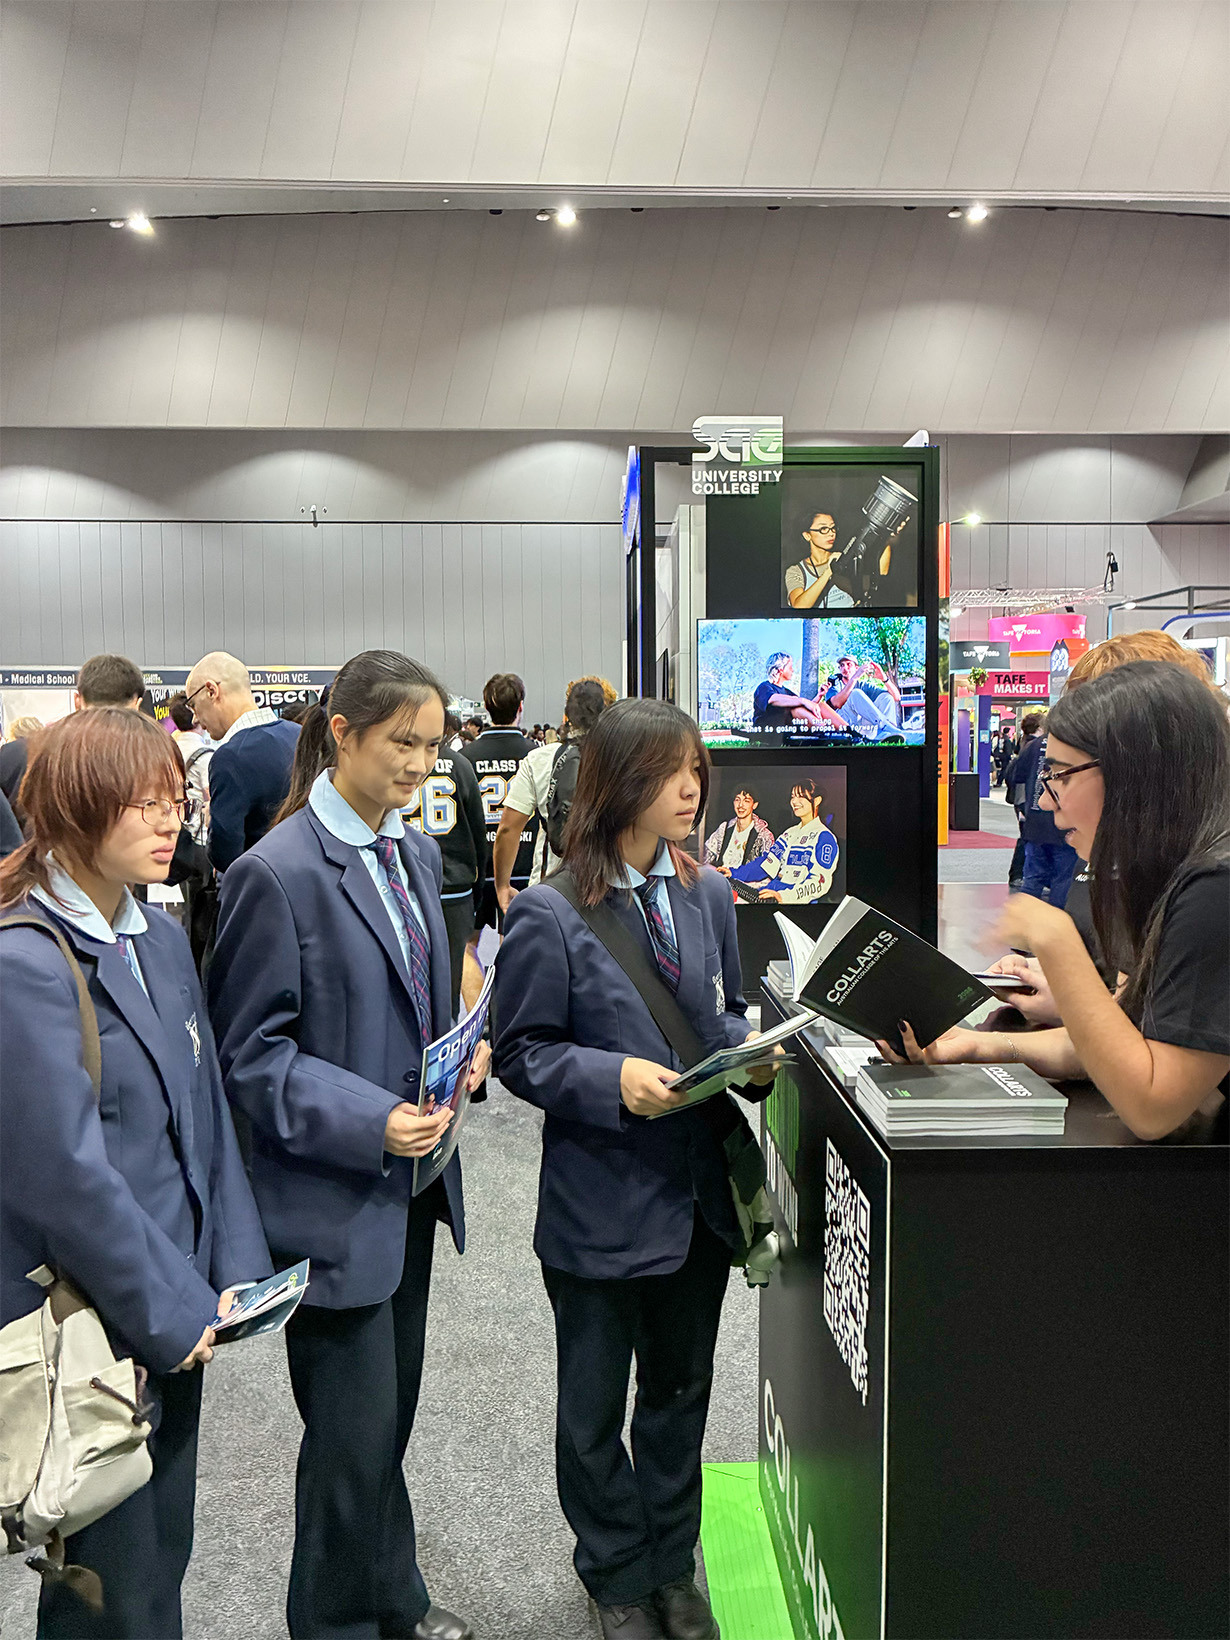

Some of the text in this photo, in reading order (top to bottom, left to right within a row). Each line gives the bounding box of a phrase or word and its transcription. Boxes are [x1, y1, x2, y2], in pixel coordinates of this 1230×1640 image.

[692, 470, 783, 482] UNIVERSITY
[692, 482, 760, 495] COLLEGE
[11, 674, 45, 684] Medical
[46, 674, 75, 684] School
[250, 674, 311, 684] LD. YOUR VCE.
[995, 674, 1026, 684] TAFE
[994, 684, 1046, 694] MAKES IT
[811, 725, 836, 733] propel
[434, 758, 454, 773] OF
[476, 760, 516, 774] CLASS
[826, 930, 892, 1002] COLLARTS
[837, 980, 860, 1006] AUSTRALIAN
[857, 961, 876, 980] COLLEGE
[438, 1020, 477, 1062] Open
